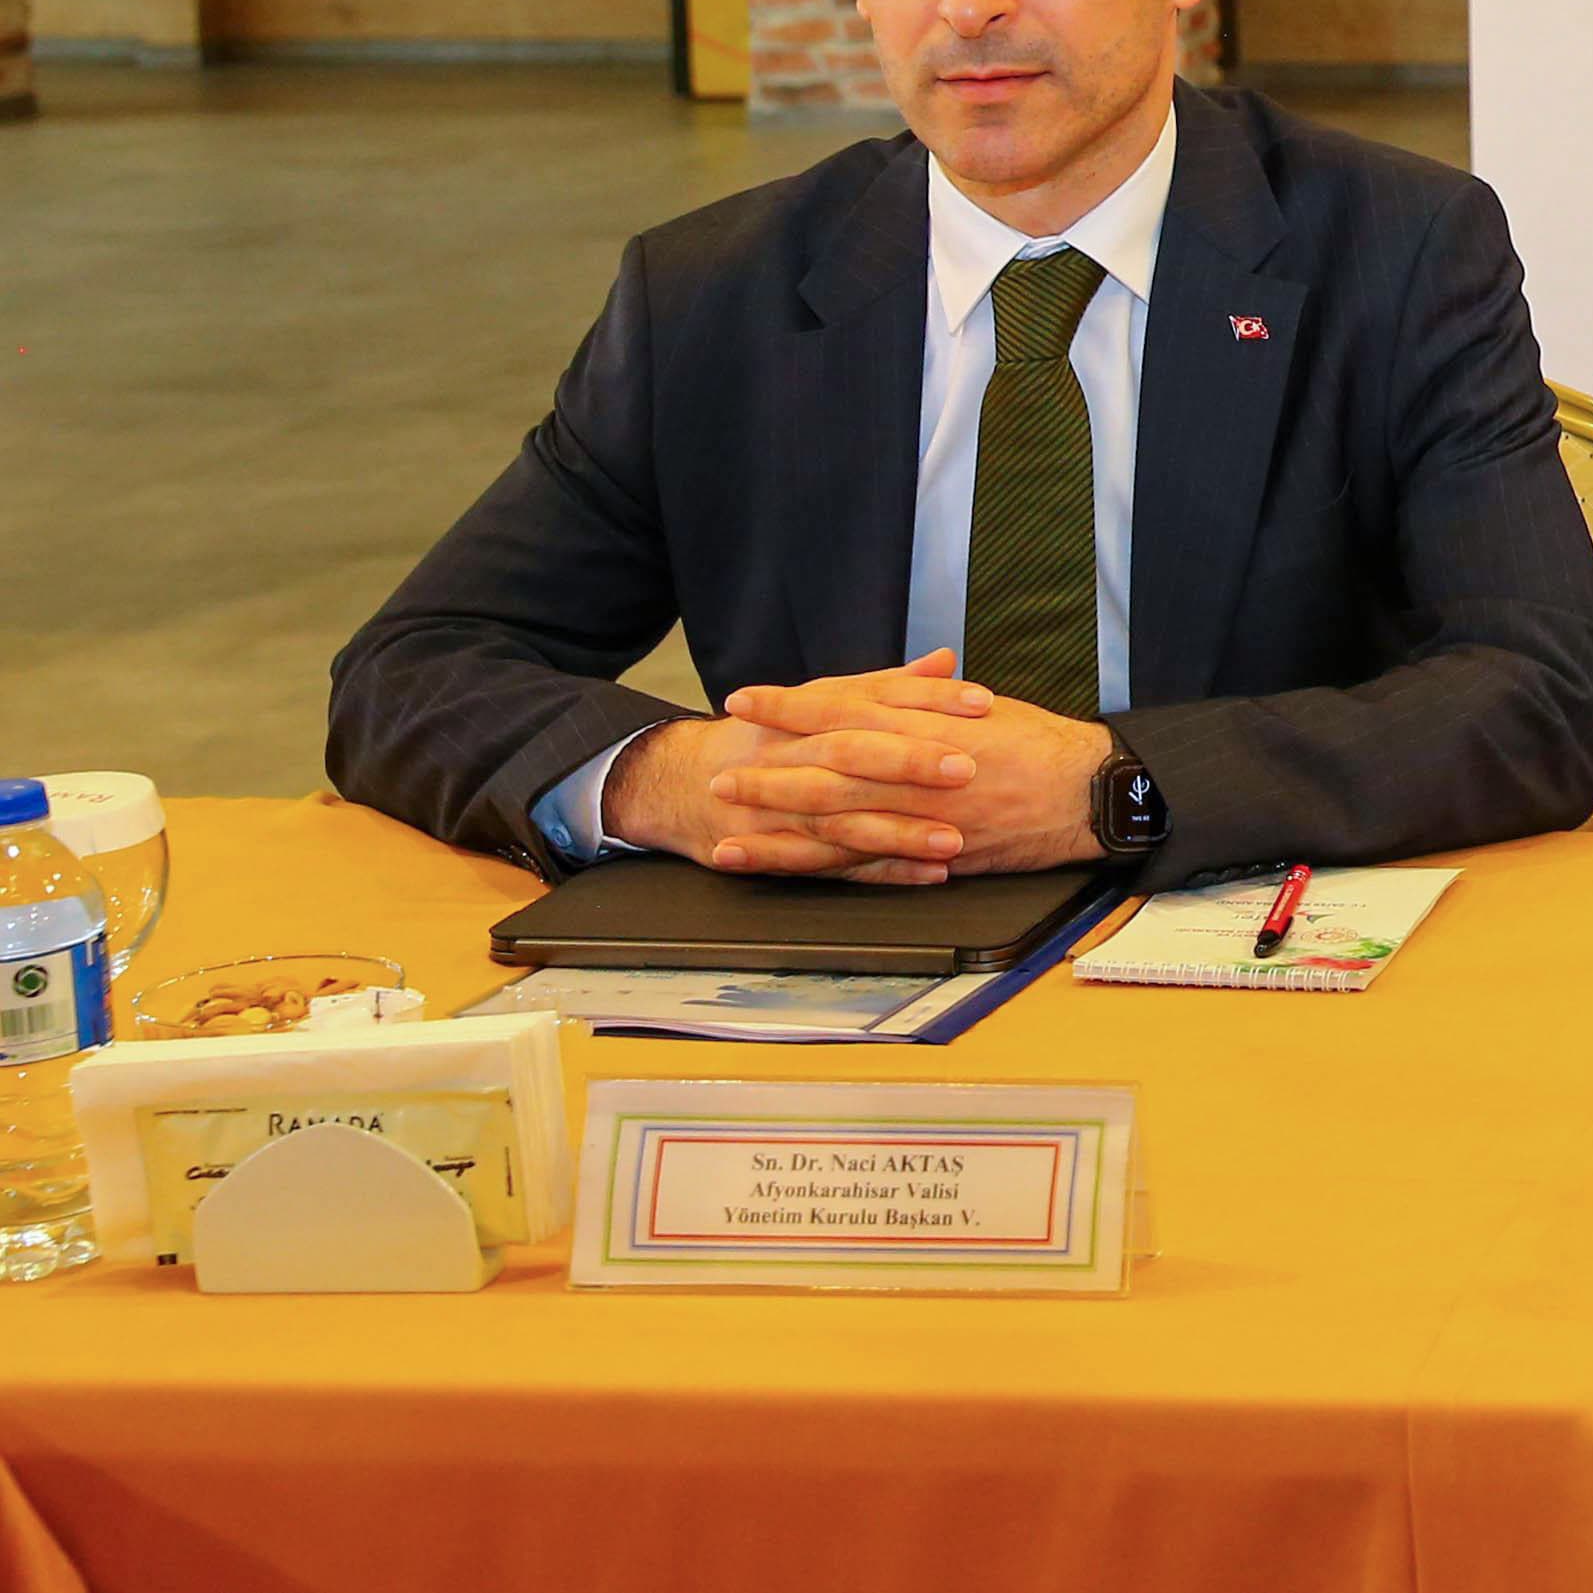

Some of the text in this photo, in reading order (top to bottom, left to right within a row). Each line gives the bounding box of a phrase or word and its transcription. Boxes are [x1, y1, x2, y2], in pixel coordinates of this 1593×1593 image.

[268, 1112, 384, 1136] RADA
[751, 1153, 965, 1177] Sn. Dr. Naci AKTAŞ
[750, 1181, 960, 1202] Afyonkarahisar Valisi
[723, 1206, 981, 1230] Yönetim Kurulu Başkan V.
